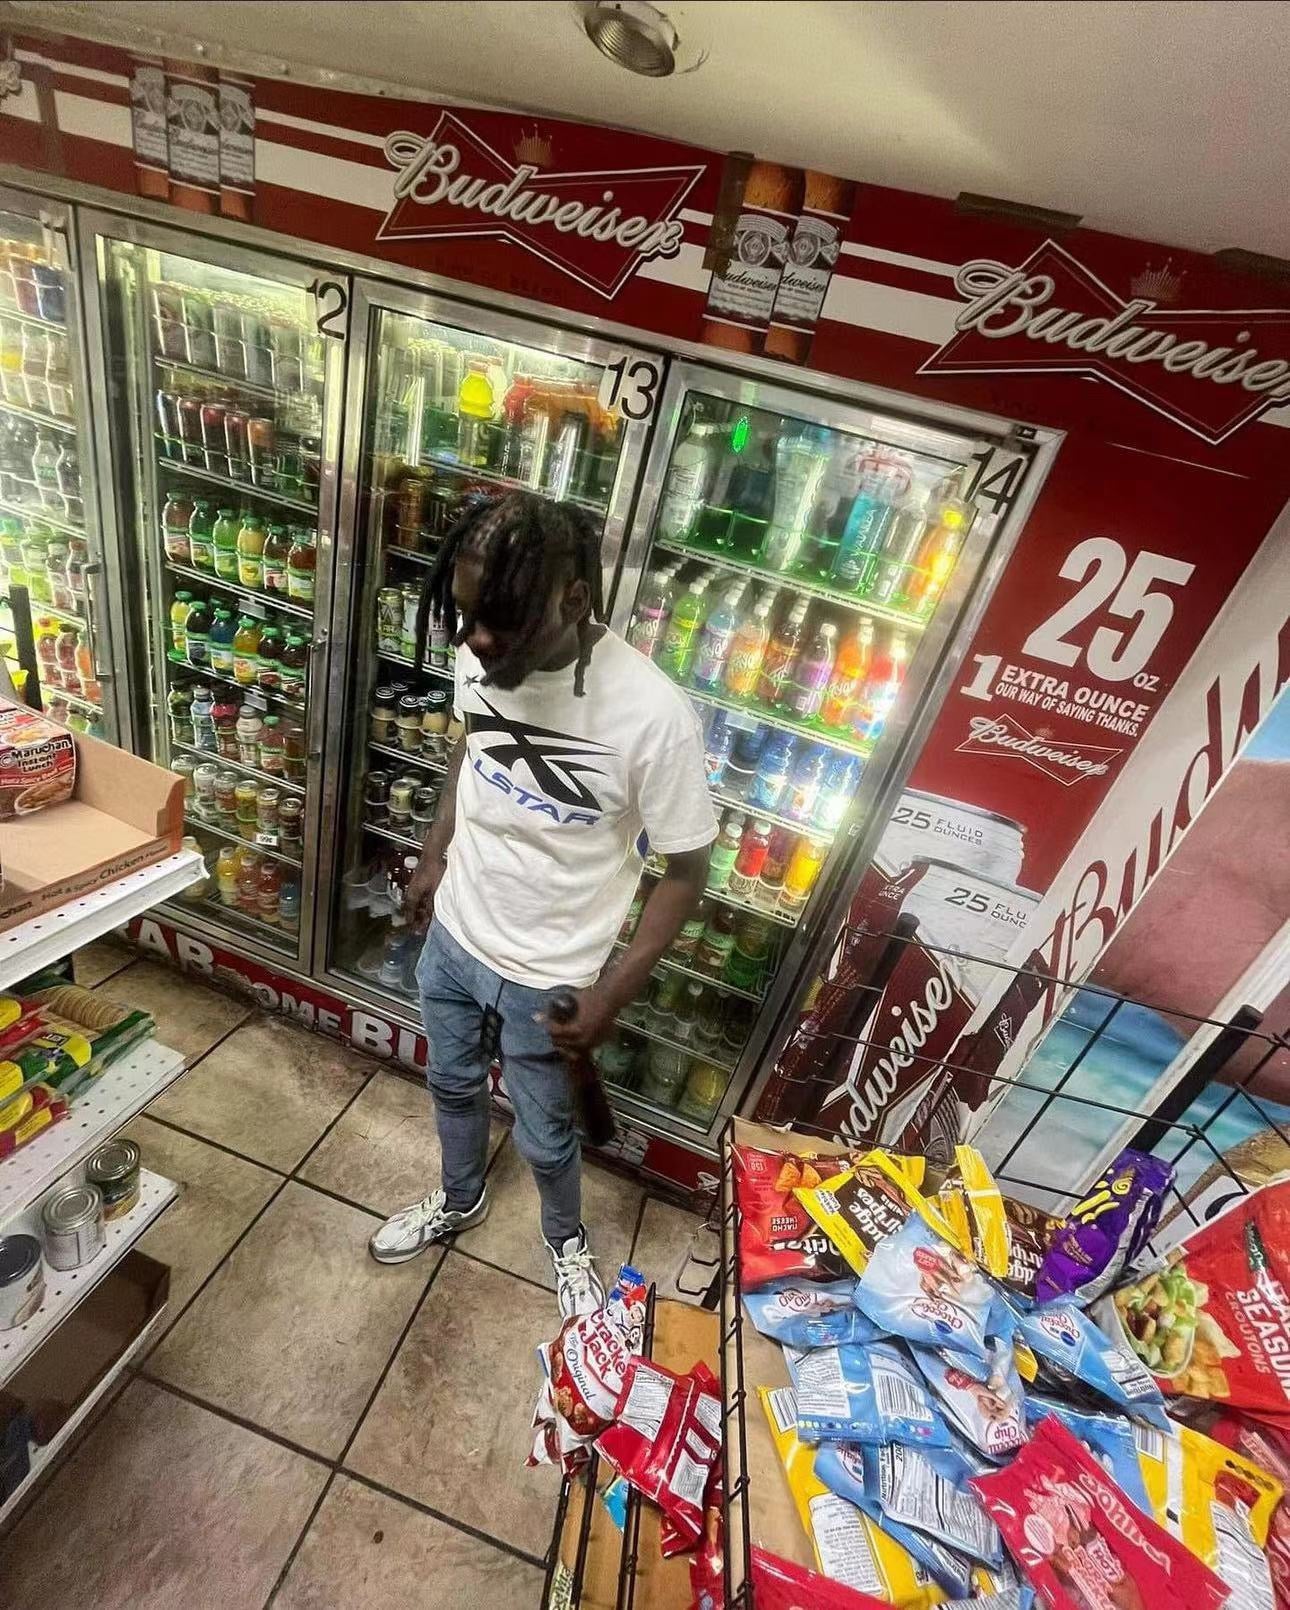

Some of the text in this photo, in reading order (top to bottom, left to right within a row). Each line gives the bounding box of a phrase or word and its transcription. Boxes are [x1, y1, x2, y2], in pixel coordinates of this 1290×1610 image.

[383, 131, 684, 259] Budweiser
[306, 279, 347, 339] 12
[607, 356, 659, 420] 13
[965, 447, 1024, 516] 14
[1020, 537, 1196, 692] 25 OZ
[960, 653, 1150, 722] 1 EXTRA OUNCE
[995, 682, 1139, 738] OUR WAY OF SAYING THANKS.
[11, 739, 70, 760] Maruchan
[22, 760, 54, 773] Lunch
[969, 716, 1110, 777] Budweiser
[889, 807, 984, 839] 25 FLUID
[933, 825, 983, 846] OUNCES
[99, 851, 147, 881] Chicken
[944, 886, 1027, 920] 25 FLU
[990, 910, 1027, 929] OUNC
[849, 1202, 889, 1243] udge
[580, 1329, 613, 1381] Jack
[591, 1308, 627, 1377] Cracke
[1224, 1290, 1272, 1375] CROUTONS
[566, 1348, 597, 1401] Original
[994, 1425, 1017, 1441] Chip
